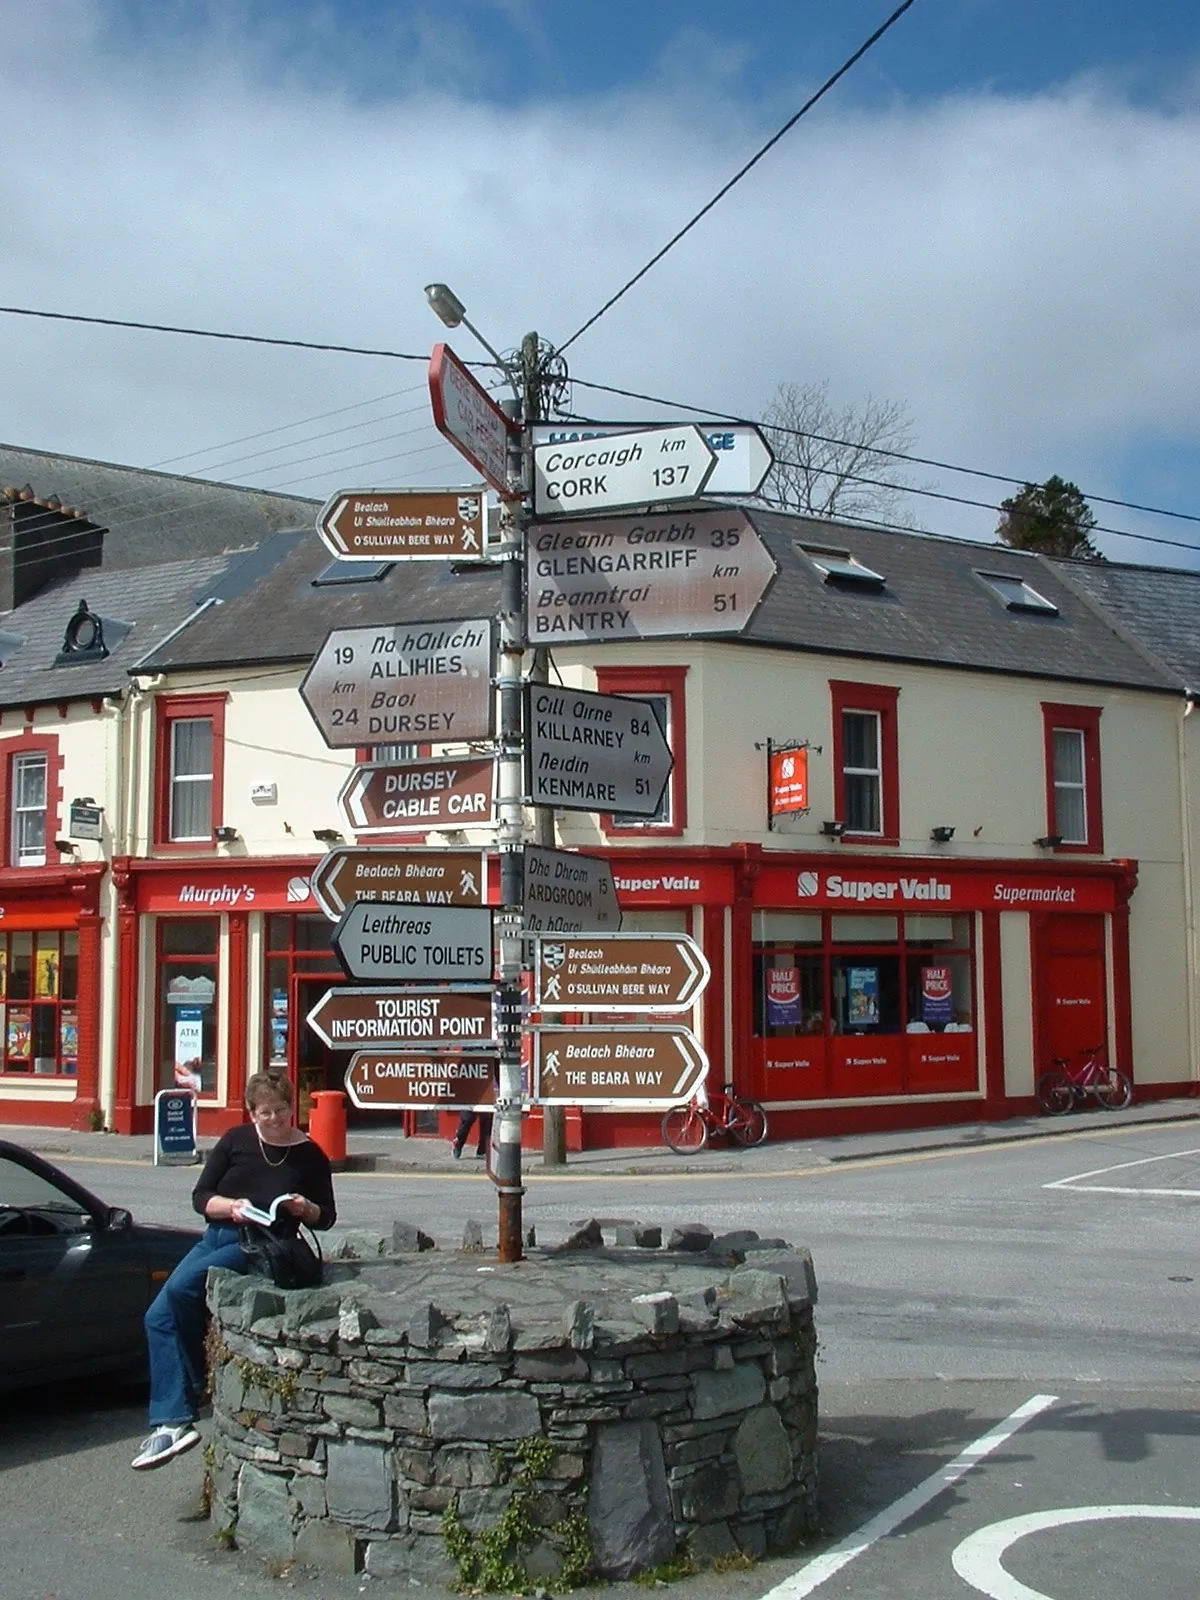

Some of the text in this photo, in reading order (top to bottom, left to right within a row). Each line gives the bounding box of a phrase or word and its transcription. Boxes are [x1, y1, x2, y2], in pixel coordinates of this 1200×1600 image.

[660, 439, 686, 453] km
[546, 443, 643, 473] Corcaigh
[652, 466, 690, 487] 137
[546, 475, 608, 500] CORK
[354, 502, 389, 512] Bealach
[354, 535, 455, 546] O'SULLIVAN BERE WAY
[537, 522, 696, 552] Gleann Garbh
[710, 528, 740, 549] 35
[536, 549, 698, 578] GLENGARRIFF
[712, 563, 740, 579] km
[713, 593, 738, 612] 51
[536, 610, 631, 634] BANTRY
[334, 647, 354, 665] 19
[370, 656, 462, 680] ALLIHIES
[333, 681, 355, 694] km
[371, 692, 416, 709] Baoi
[536, 696, 564, 716] Cill
[331, 709, 359, 726] 24
[369, 713, 455, 734] DURSEY
[537, 721, 625, 749] KILLARNEY
[630, 718, 650, 737] 84
[634, 751, 651, 765] km
[385, 770, 458, 793] DURSEY
[538, 777, 617, 802] KENMARE
[635, 779, 651, 796] 51
[382, 793, 487, 819] CABLE CAR
[356, 864, 401, 877] Bealach
[179, 884, 256, 906] Murphy's
[598, 878, 608, 895] 15
[994, 884, 1076, 904] Supermarket
[356, 891, 453, 904] THE BEARA WAY
[528, 883, 593, 908] ARDGROOM
[362, 914, 432, 935] Leithreas
[361, 944, 485, 966] PUBLIC TOILETS
[568, 949, 604, 960] Bealach
[772, 971, 794, 982] HALF
[927, 969, 946, 979] HALF
[568, 984, 671, 995] O'SULLIVAN BERE WAY
[771, 983, 796, 994] PRICE
[925, 980, 948, 991] PRICE
[376, 999, 441, 1018] TOURIST
[180, 1028, 199, 1037] ATM
[332, 1017, 485, 1037] INFORMATION POINT
[566, 1046, 611, 1059] Bealach
[361, 1064, 369, 1080] 1
[375, 1062, 489, 1079] CAMETRINGANE
[566, 1072, 664, 1085] THE BEARA WAY
[356, 1082, 374, 1095] km
[408, 1082, 456, 1097] HOTEL
